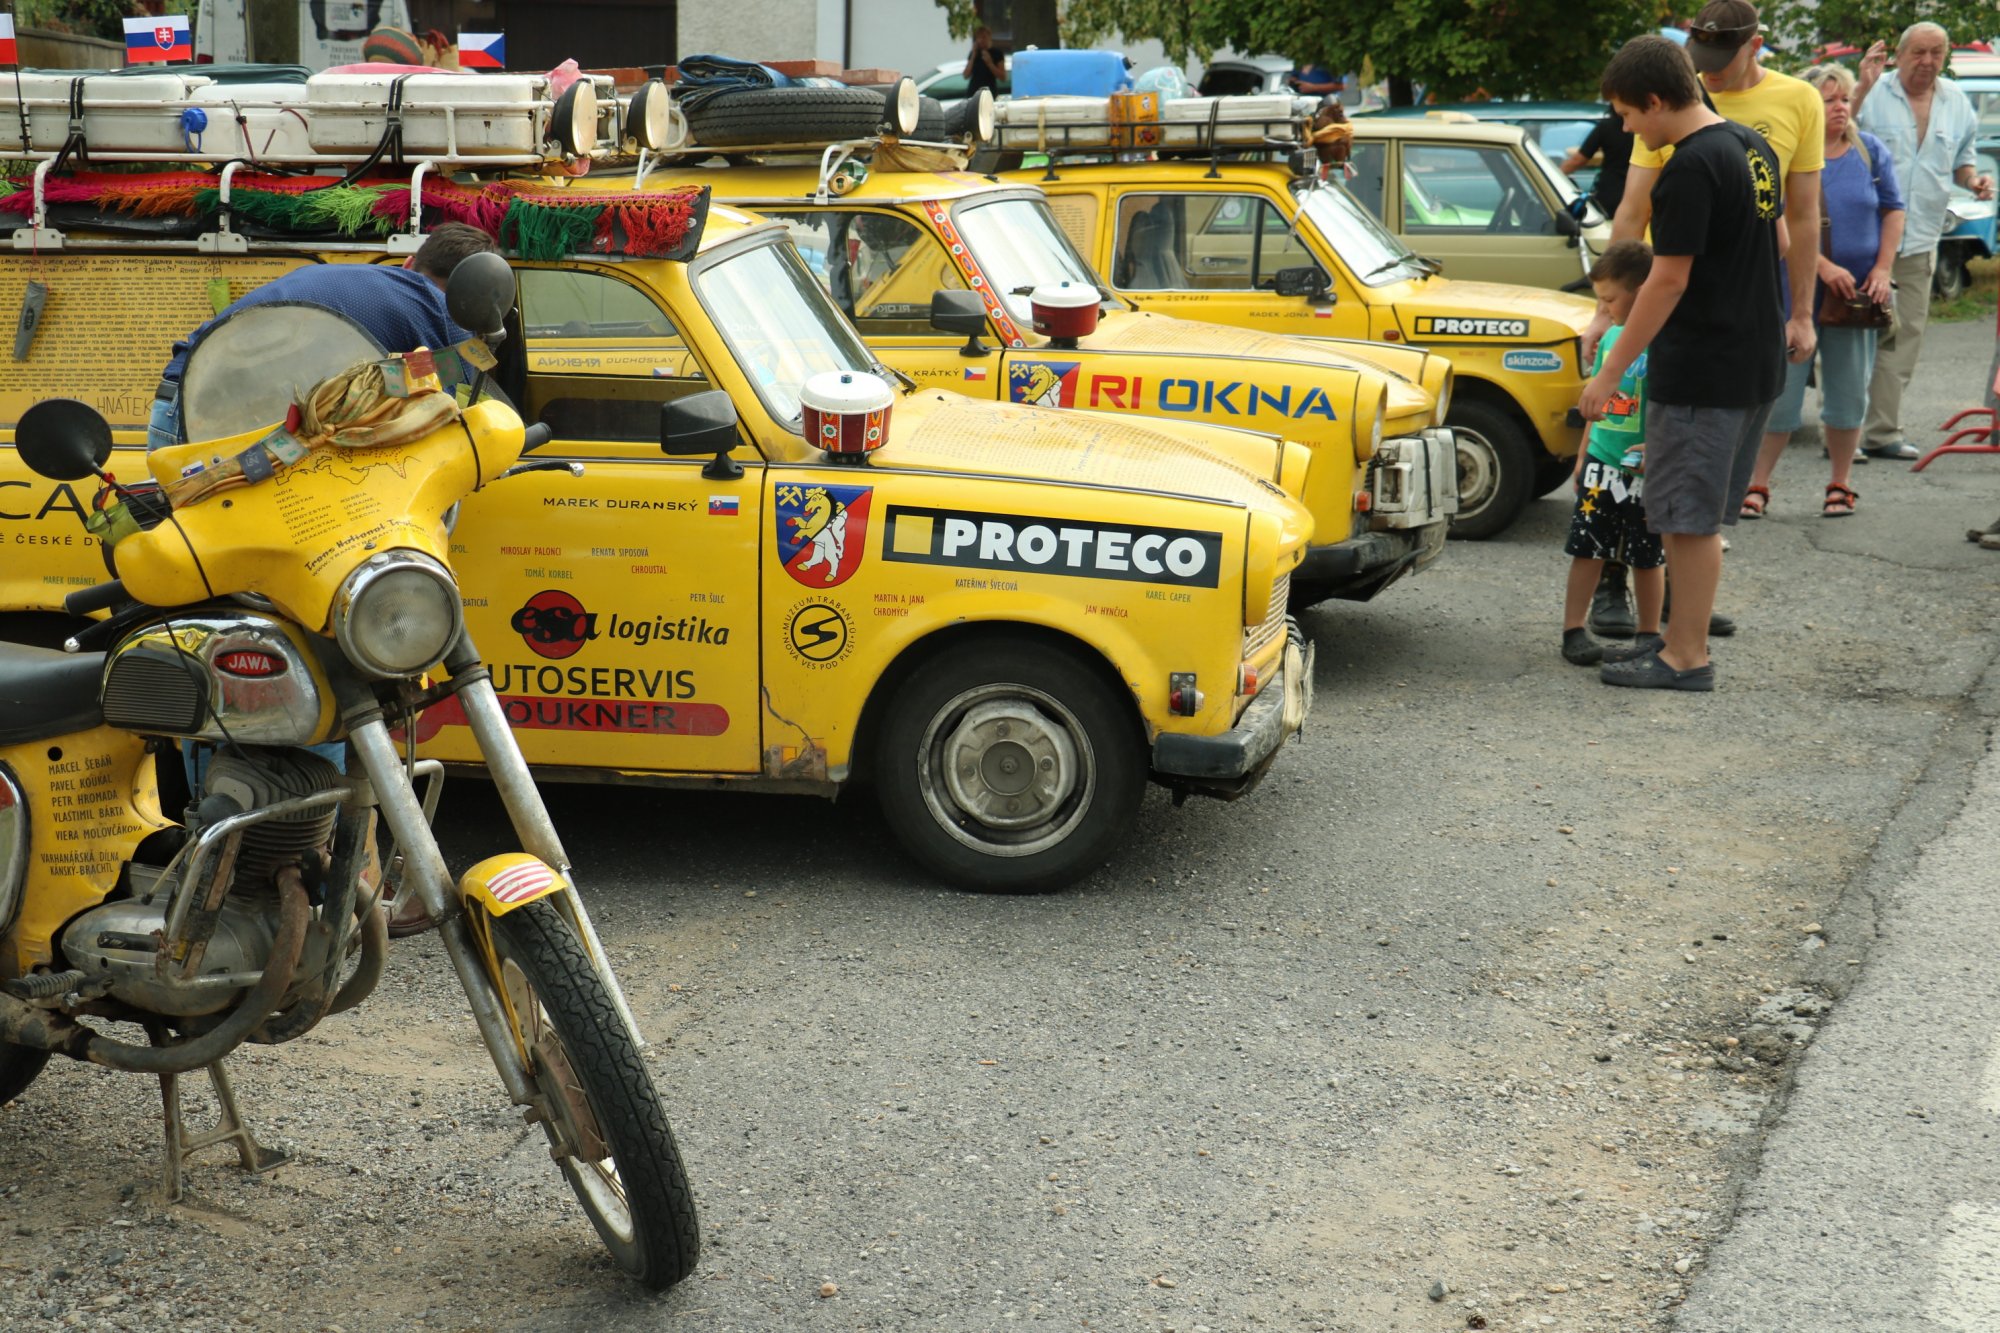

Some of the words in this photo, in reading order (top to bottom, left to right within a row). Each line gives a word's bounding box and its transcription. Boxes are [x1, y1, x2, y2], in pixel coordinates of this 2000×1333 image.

[1433, 318, 1526, 336] PROTECO
[913, 367, 960, 377] KRÁTKÝ
[96, 390, 158, 417] HNÁTEK
[1089, 374, 1142, 410] RI
[1157, 378, 1338, 422] OKNA
[273, 487, 294, 498] INDIA
[276, 493, 300, 505] NEPAL
[279, 495, 315, 512] PAKISTAN
[543, 497, 600, 508] MAREK
[606, 499, 699, 512] DURANSKÝ
[282, 506, 306, 518] CHINA
[15, 533, 73, 546] ČESKÉ
[500, 546, 531, 556] MIROSLAV
[591, 547, 616, 557] RENATA
[941, 518, 1207, 578] PROTECO
[524, 567, 545, 578] TOMÁŠ
[548, 569, 574, 580] KORBEL
[630, 565, 668, 575] CHROUSTAL
[42, 575, 64, 585] MAREK
[67, 575, 97, 586] URBÁNEK
[954, 577, 987, 590] KATEŘINA
[989, 579, 1019, 592] ŠVECOVÁ
[461, 596, 488, 607] BATICKÁ
[689, 593, 707, 603] PETR
[874, 593, 898, 603] MARTIN
[900, 595, 906, 603] A
[908, 595, 925, 605] JANA
[1145, 589, 1167, 601] KAREL
[782, 595, 814, 631] MUZEUM
[873, 605, 909, 617] CHROMÝCH
[1084, 604, 1097, 615] JAN
[1100, 605, 1129, 618] HYNČICA
[608, 613, 730, 646] logistika
[228, 655, 272, 671] JAWA
[801, 659, 817, 670] VES
[819, 660, 838, 670] POD
[487, 664, 696, 700] UTOSERVIS
[502, 700, 678, 730] OUKNER
[48, 761, 81, 776] MARCEL
[50, 780, 76, 792] PAVEL
[52, 796, 74, 808] PETR
[77, 789, 119, 806] HROMADA
[53, 809, 95, 823] VLASTIMIL
[99, 804, 125, 819] BÁRTA
[56, 829, 80, 841] VIERA
[99, 848, 119, 862] DÍLNA
